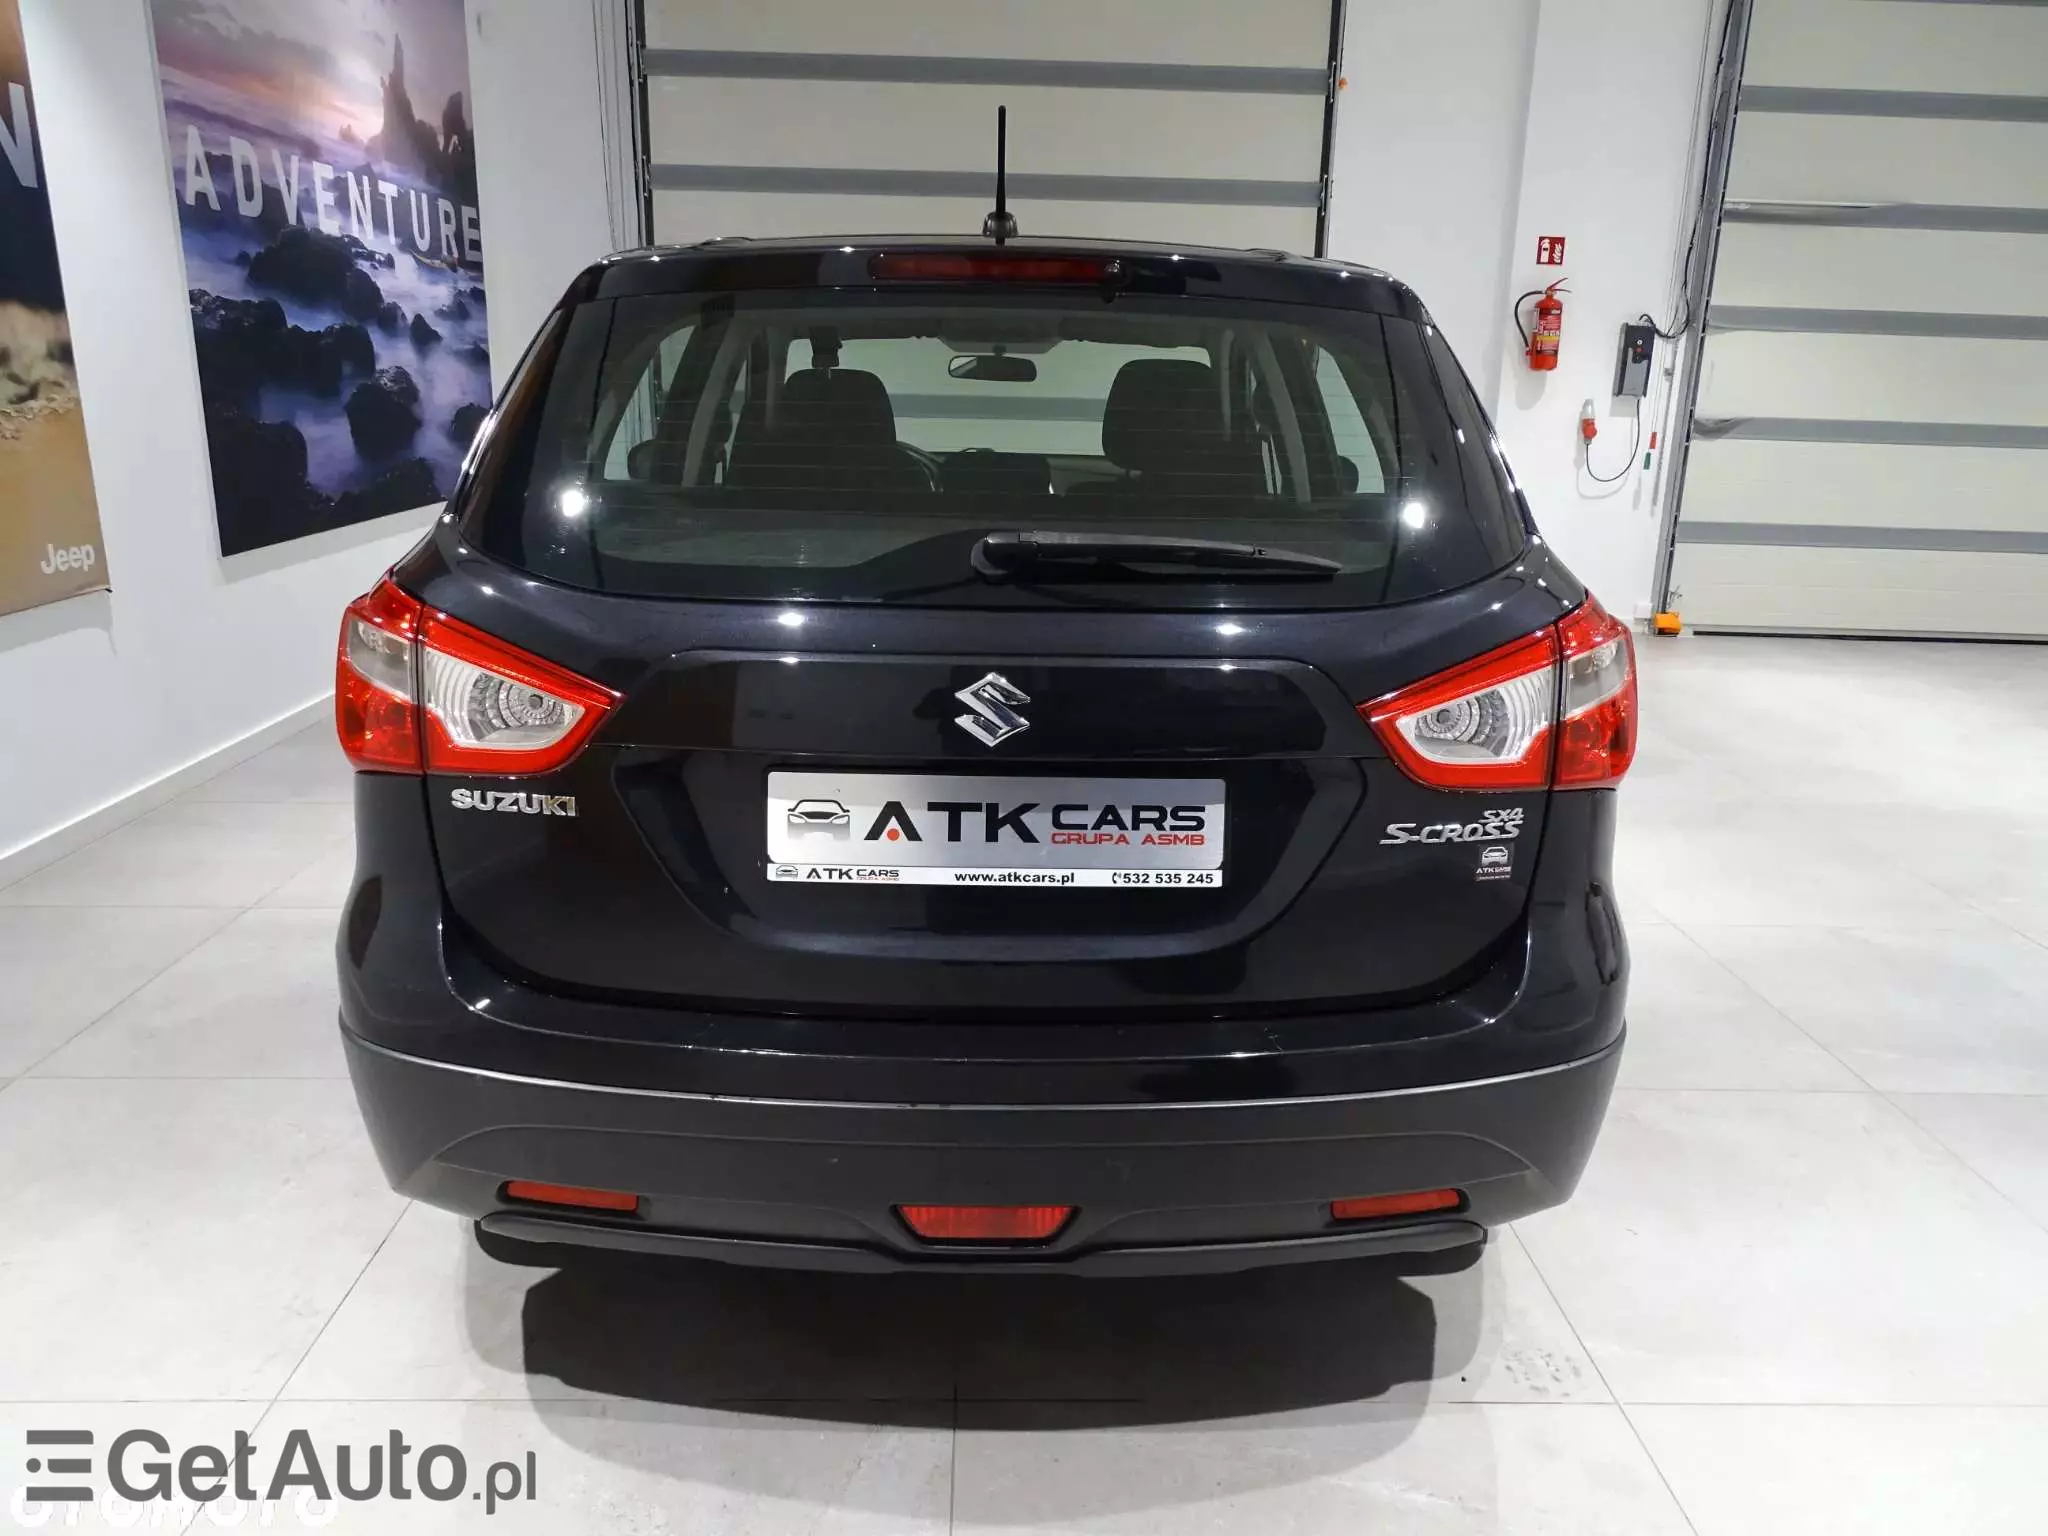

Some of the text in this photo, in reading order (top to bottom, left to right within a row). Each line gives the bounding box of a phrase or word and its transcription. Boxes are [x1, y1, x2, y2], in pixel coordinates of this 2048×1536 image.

[185, 124, 481, 263] ADVENTURE
[41, 543, 96, 574] Jeep
[451, 788, 577, 817] SUZUKI
[1478, 807, 1525, 823] SX4
[863, 800, 1206, 844] ATK CARS
[1379, 820, 1524, 845] S-CROSS
[1051, 832, 1205, 846] GRUPA ASMB
[806, 867, 854, 880] ATK
[856, 868, 900, 878] CARS
[954, 871, 1075, 885] www.atkcars.pl
[1122, 872, 1150, 884] 532
[1155, 872, 1182, 884] 535
[1187, 873, 1214, 885] 245
